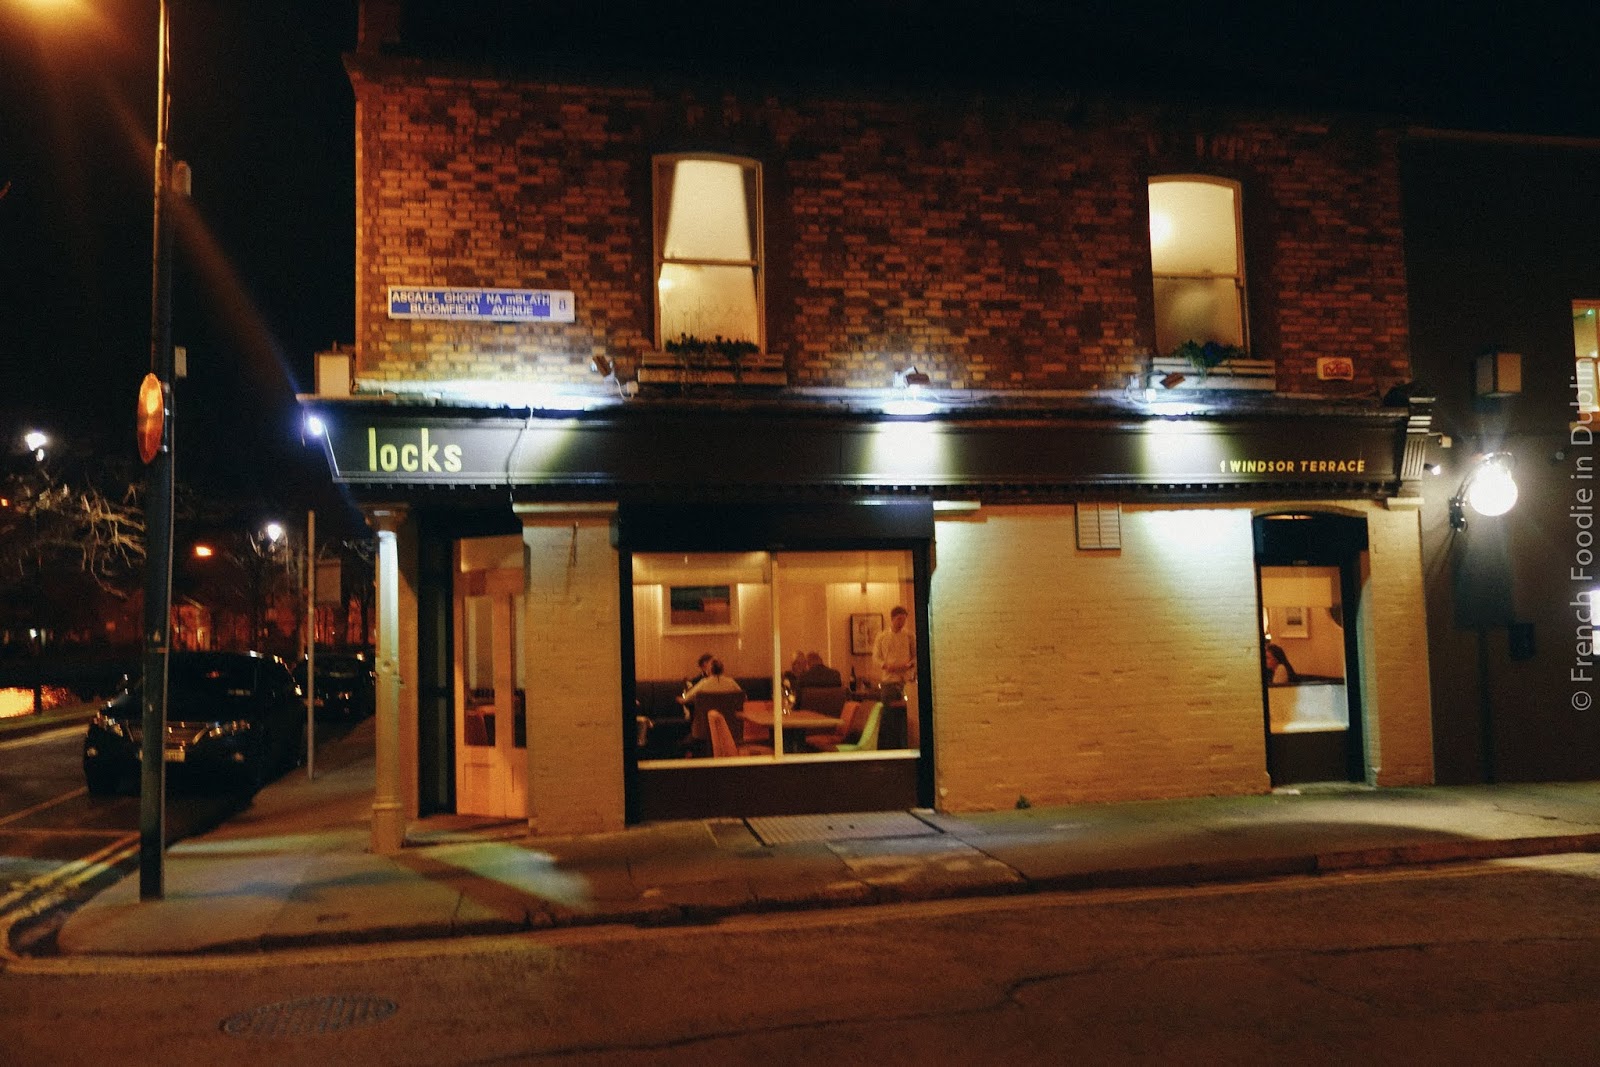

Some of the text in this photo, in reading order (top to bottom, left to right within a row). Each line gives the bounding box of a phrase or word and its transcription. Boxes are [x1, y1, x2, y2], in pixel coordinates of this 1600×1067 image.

[486, 293, 502, 305] NA
[410, 303, 533, 316] BLOOMFIELD AVENUE
[368, 427, 463, 473] locks
[1229, 460, 1295, 472] WINDSOR
[1300, 460, 1366, 473] TERRACE
